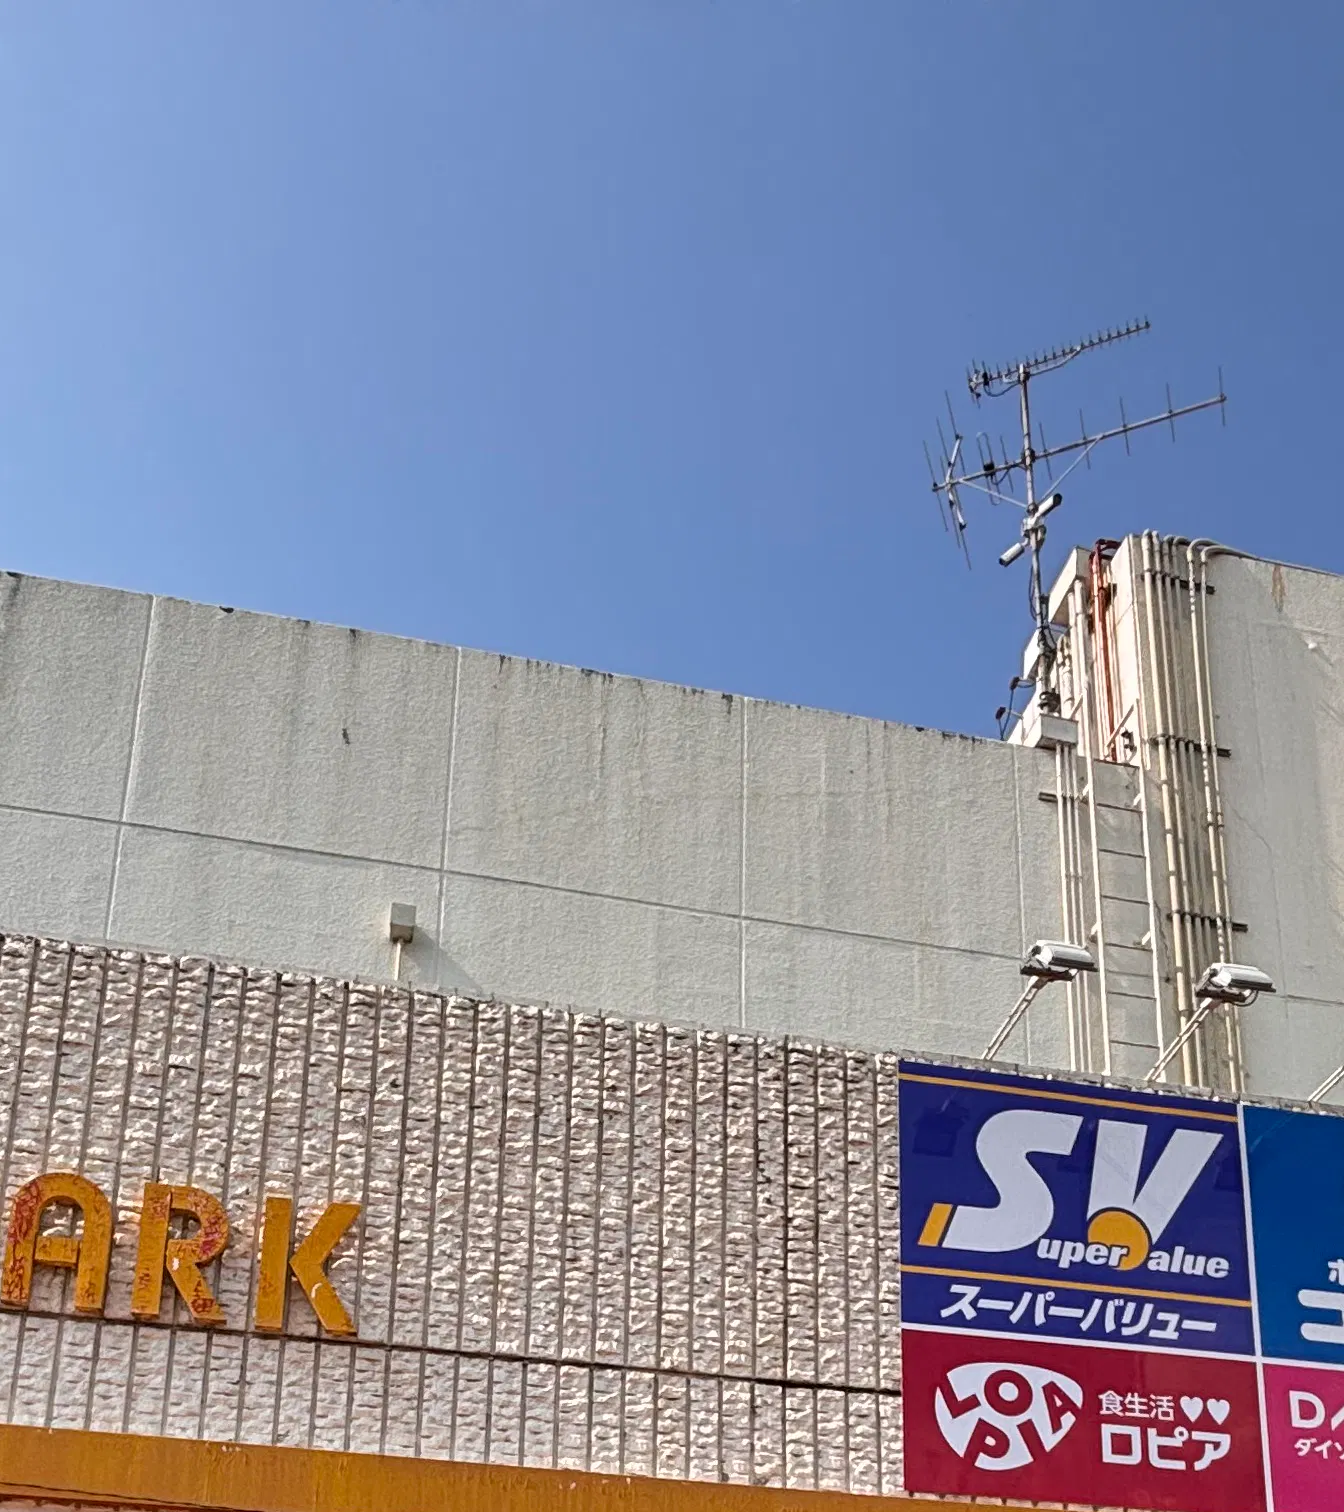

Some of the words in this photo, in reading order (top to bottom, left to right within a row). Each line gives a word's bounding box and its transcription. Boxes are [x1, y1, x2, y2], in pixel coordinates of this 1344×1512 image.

[940, 1284, 1217, 1340] スーパーバリュー
[1098, 1390, 1175, 1422] 食生活
[1101, 1424, 1231, 1471] ロピア
